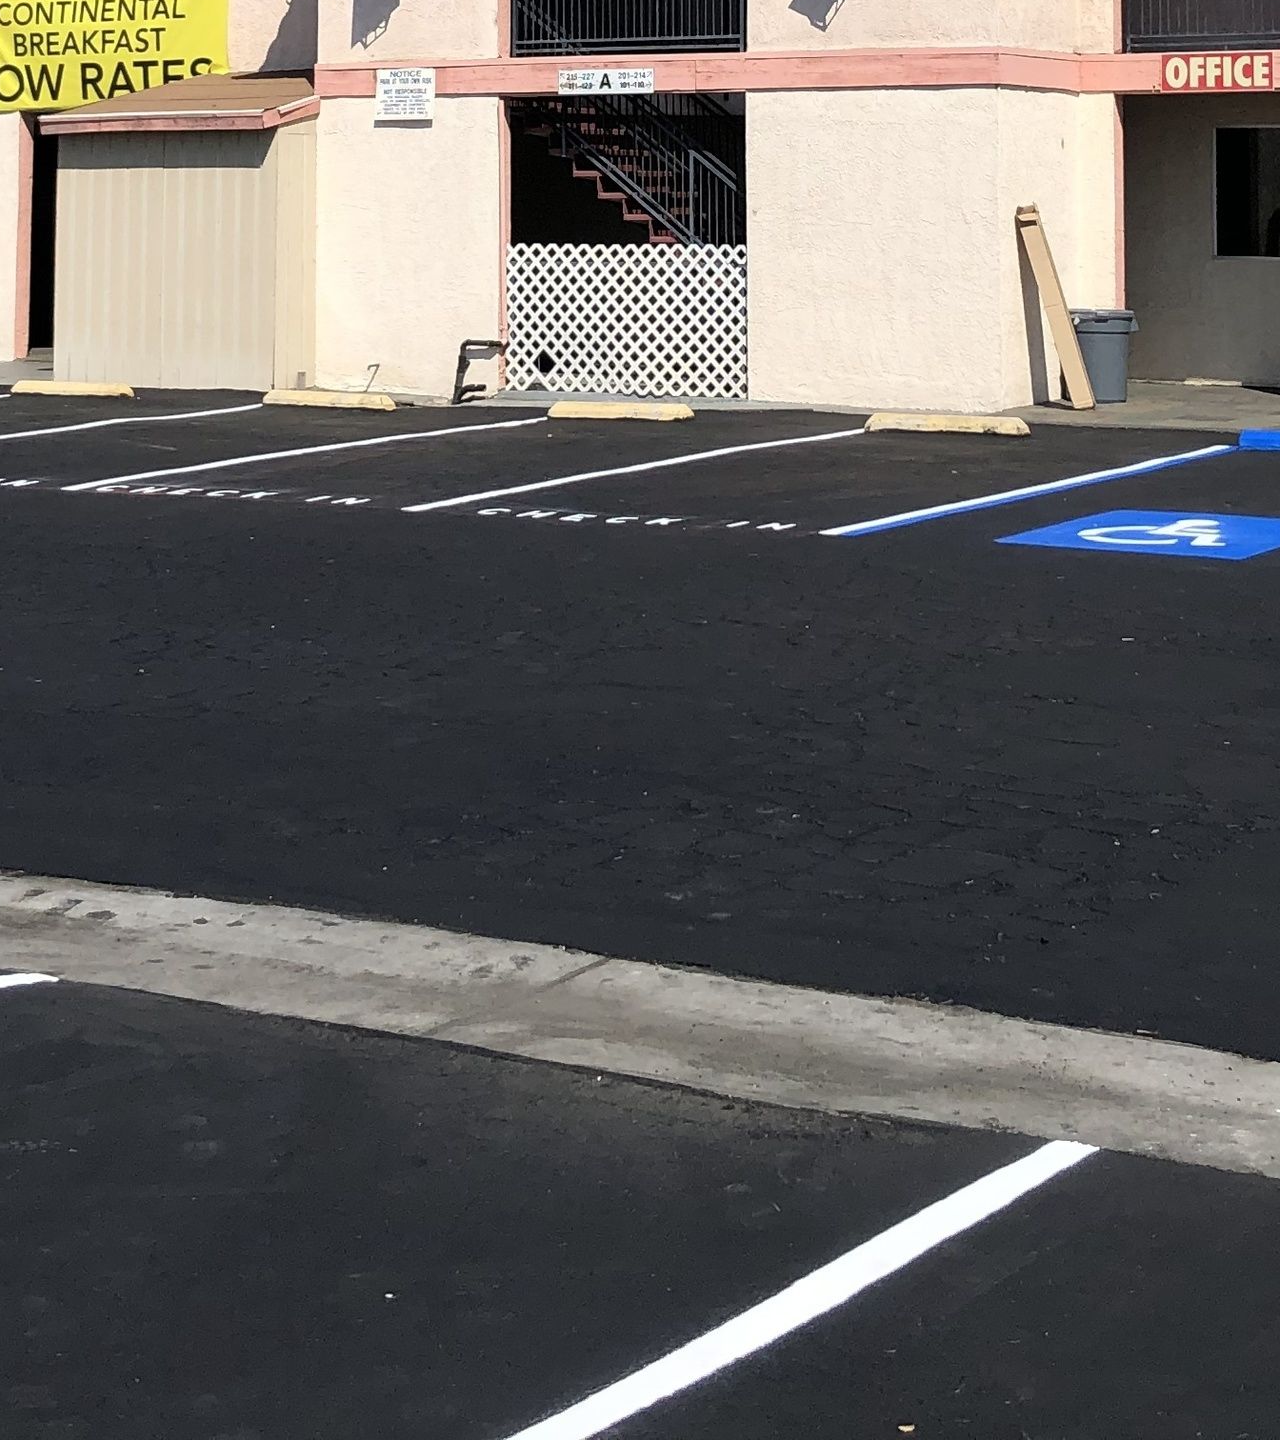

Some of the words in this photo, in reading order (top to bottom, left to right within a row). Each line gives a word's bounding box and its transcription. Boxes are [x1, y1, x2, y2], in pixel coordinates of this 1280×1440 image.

[13, 27, 166, 57] BREAKFAST
[599, 73, 612, 89] A
[1165, 55, 1269, 88] OFFICE
[95, 484, 279, 499] CHECK
[304, 495, 372, 505] IN
[477, 507, 684, 526] CHECK
[725, 520, 797, 531] IN
